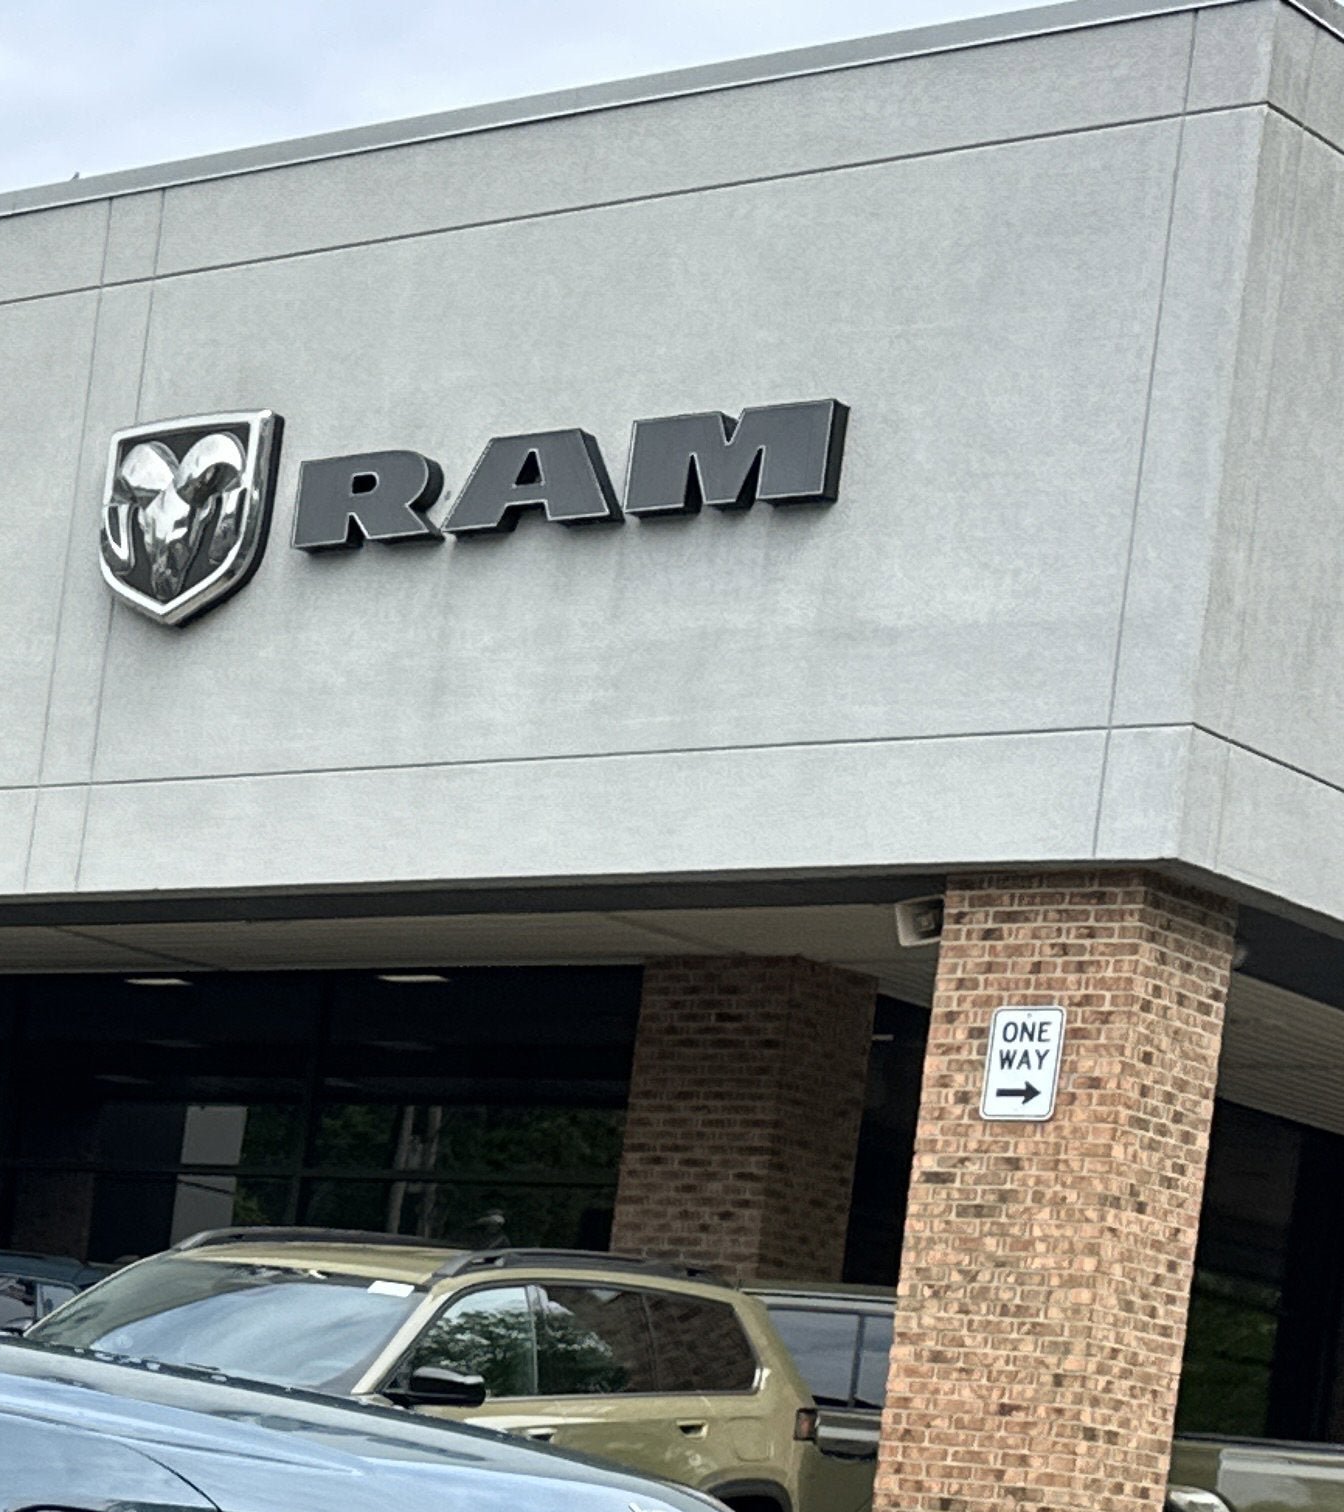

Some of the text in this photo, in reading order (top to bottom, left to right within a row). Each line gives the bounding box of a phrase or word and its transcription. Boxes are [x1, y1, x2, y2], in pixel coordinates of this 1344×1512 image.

[291, 398, 850, 553] RAM
[1002, 1021, 1052, 1043] ONE
[999, 1049, 1050, 1071] WAY
